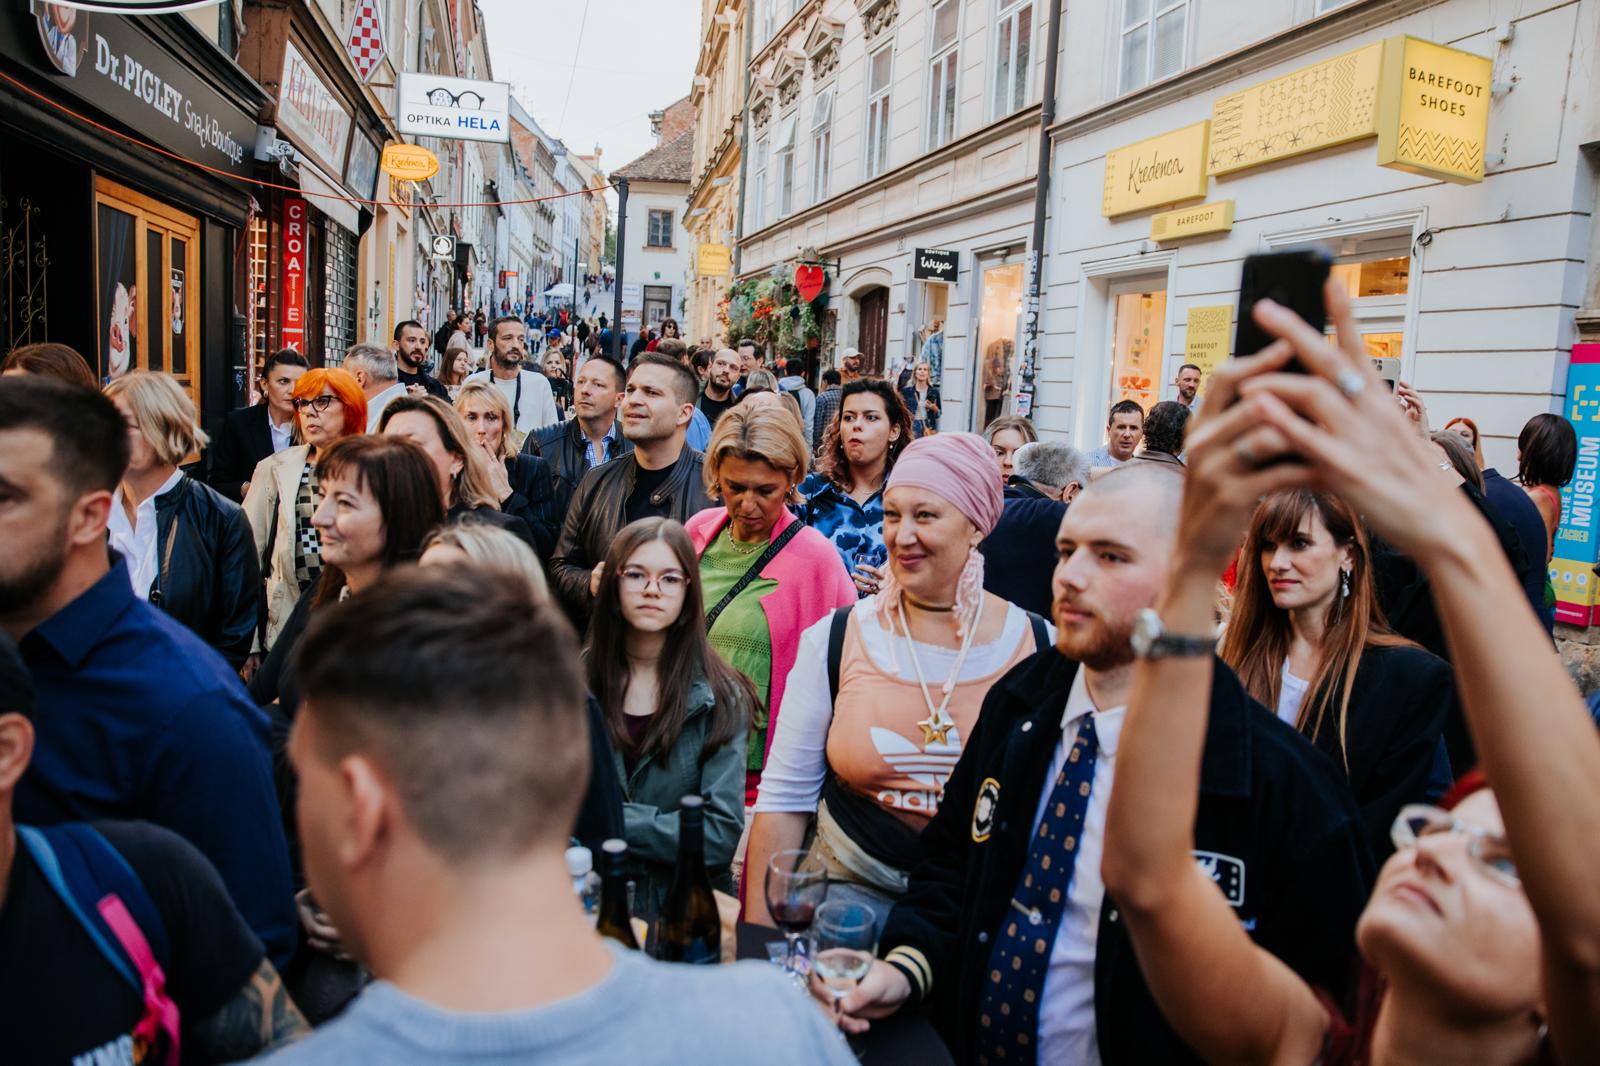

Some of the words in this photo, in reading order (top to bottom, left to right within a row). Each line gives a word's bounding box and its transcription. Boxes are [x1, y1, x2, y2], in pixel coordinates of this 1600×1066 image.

[1408, 66, 1483, 99] BAREFOOT
[1419, 93, 1467, 117] SHOES
[184, 100, 211, 149] Snack
[211, 119, 243, 167] Boutique
[407, 113, 451, 127] OPTIKA
[458, 116, 501, 131] HELA
[1127, 150, 1184, 195] Kredenca
[1176, 211, 1215, 227] BAREFOOT
[287, 204, 302, 322] CROATIE
[1190, 342, 1218, 350] BAREFOOT
[1570, 436, 1600, 528] MUSEUM
[1560, 495, 1572, 525] SELFIE
[1558, 527, 1589, 543] ZAGREB
